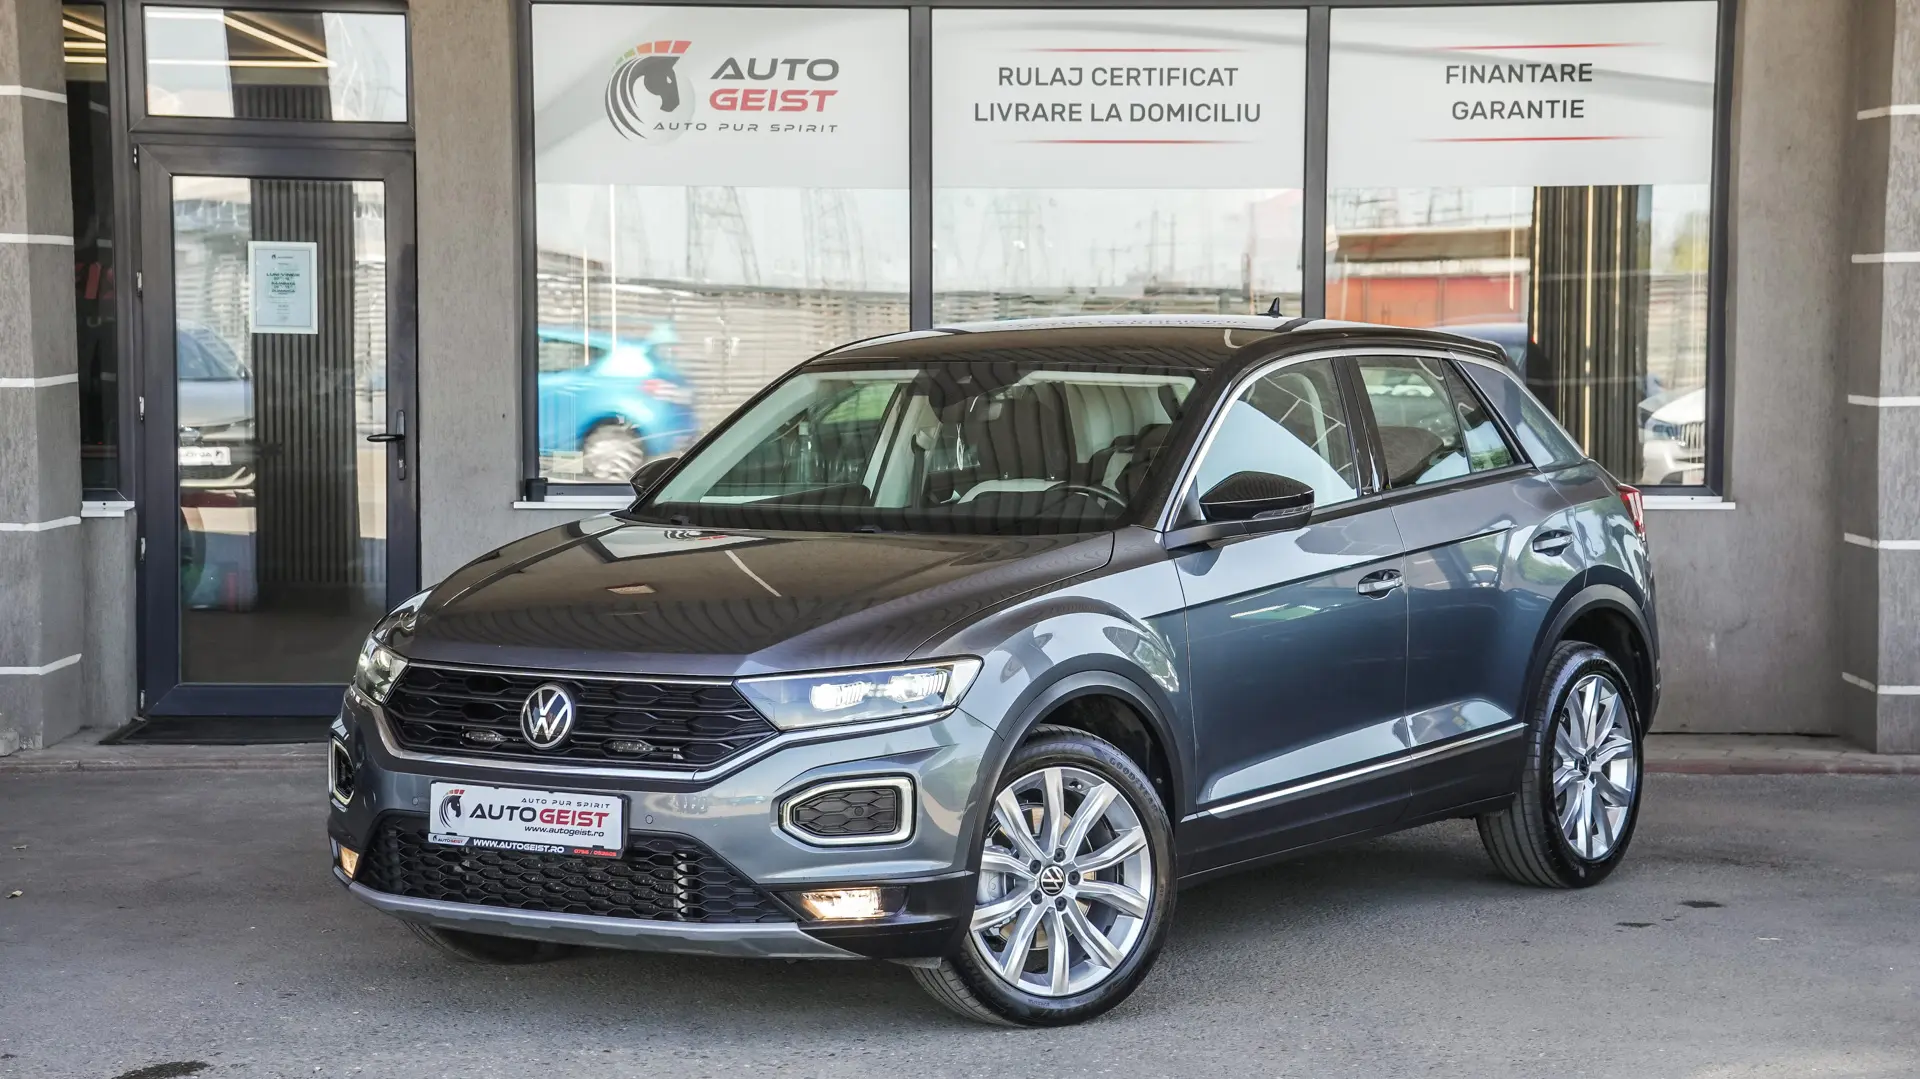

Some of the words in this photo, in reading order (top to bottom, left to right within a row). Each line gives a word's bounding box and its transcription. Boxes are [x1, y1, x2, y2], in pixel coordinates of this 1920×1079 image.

[709, 57, 840, 82] AUTO
[998, 66, 1084, 87] RULAJ
[1090, 66, 1240, 87] CERTIFICAT
[1445, 62, 1593, 84] FINANTARE
[708, 88, 839, 112] GEIST
[1451, 99, 1585, 121] GARANTIE
[973, 102, 1083, 122] LIVRARE
[1090, 103, 1123, 122] LA
[1129, 102, 1262, 122] DOMICILIU
[652, 122, 708, 132] AUTO
[718, 123, 759, 132] PUR
[769, 123, 839, 133] SPIRIT
[520, 797, 548, 805] AUTO
[551, 799, 573, 807] PUR
[576, 801, 611, 809] SPIRIT
[524, 825, 605, 837] www.autogeist.ro
[473, 838, 565, 854] WWW.AUTOGEIST.RO
